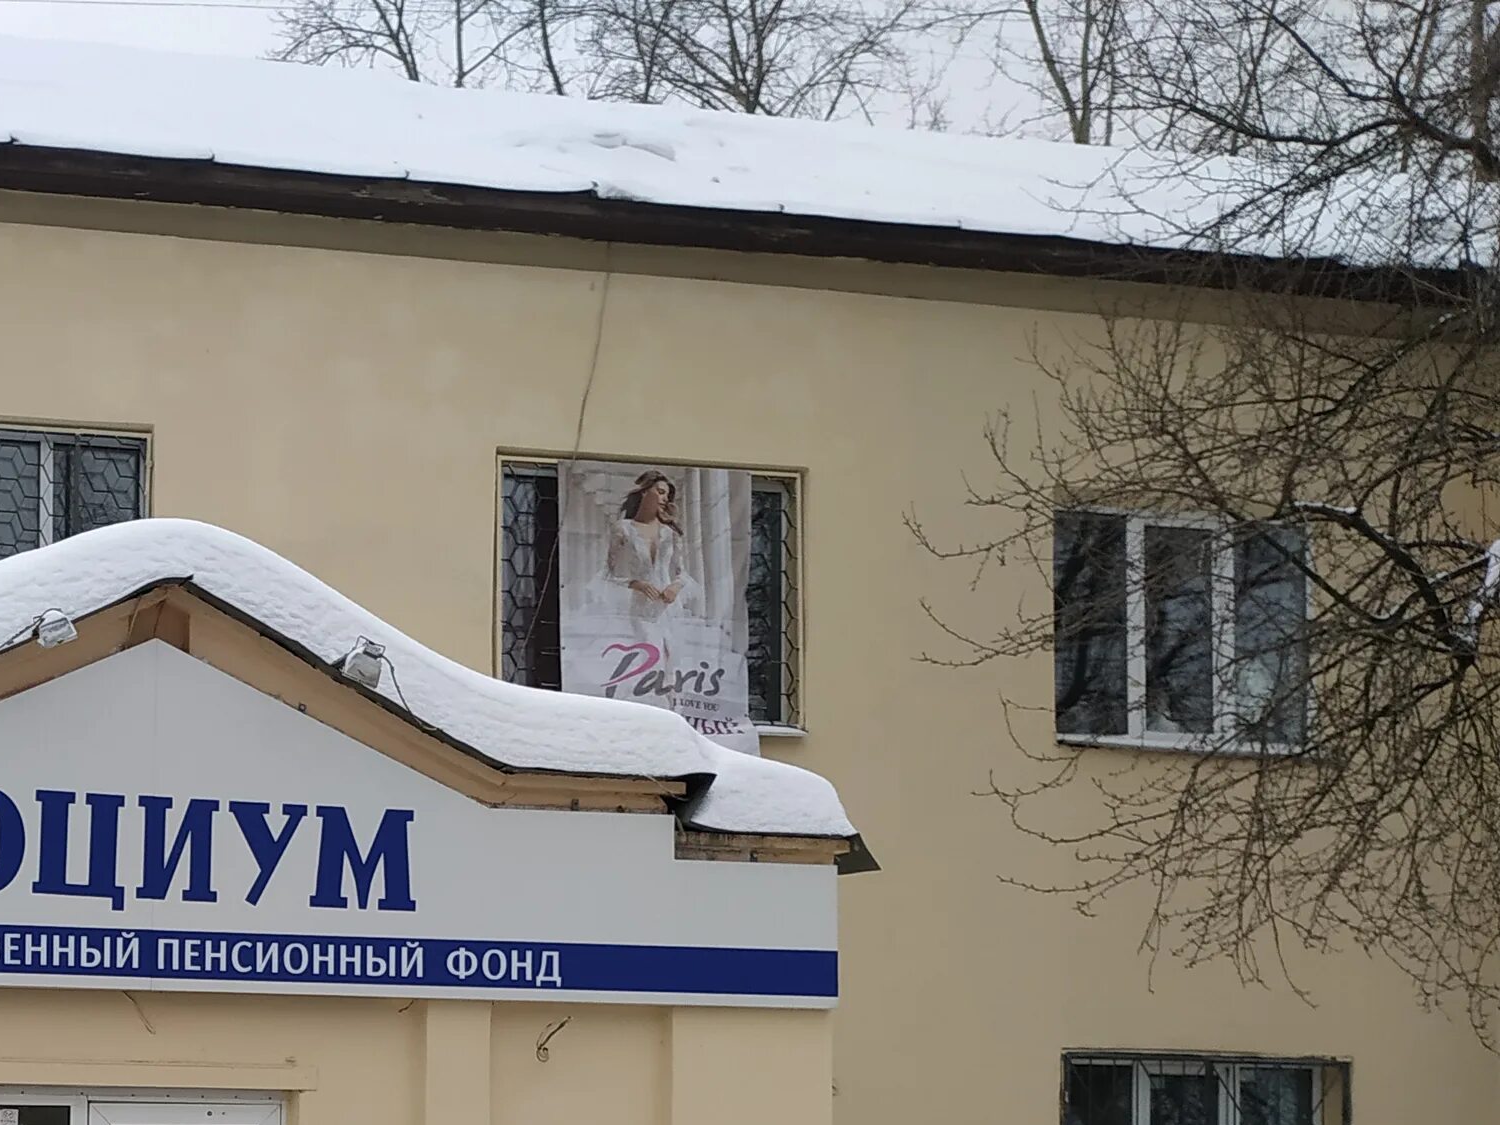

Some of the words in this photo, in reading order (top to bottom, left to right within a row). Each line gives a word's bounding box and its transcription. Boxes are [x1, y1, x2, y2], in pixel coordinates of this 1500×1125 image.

[600, 643, 725, 698] Paris
[680, 699, 702, 710] LOVE
[703, 701, 720, 712] YOU
[156, 936, 424, 979] ПЕНСИОННЫЙ
[445, 946, 562, 987] ФОНД
